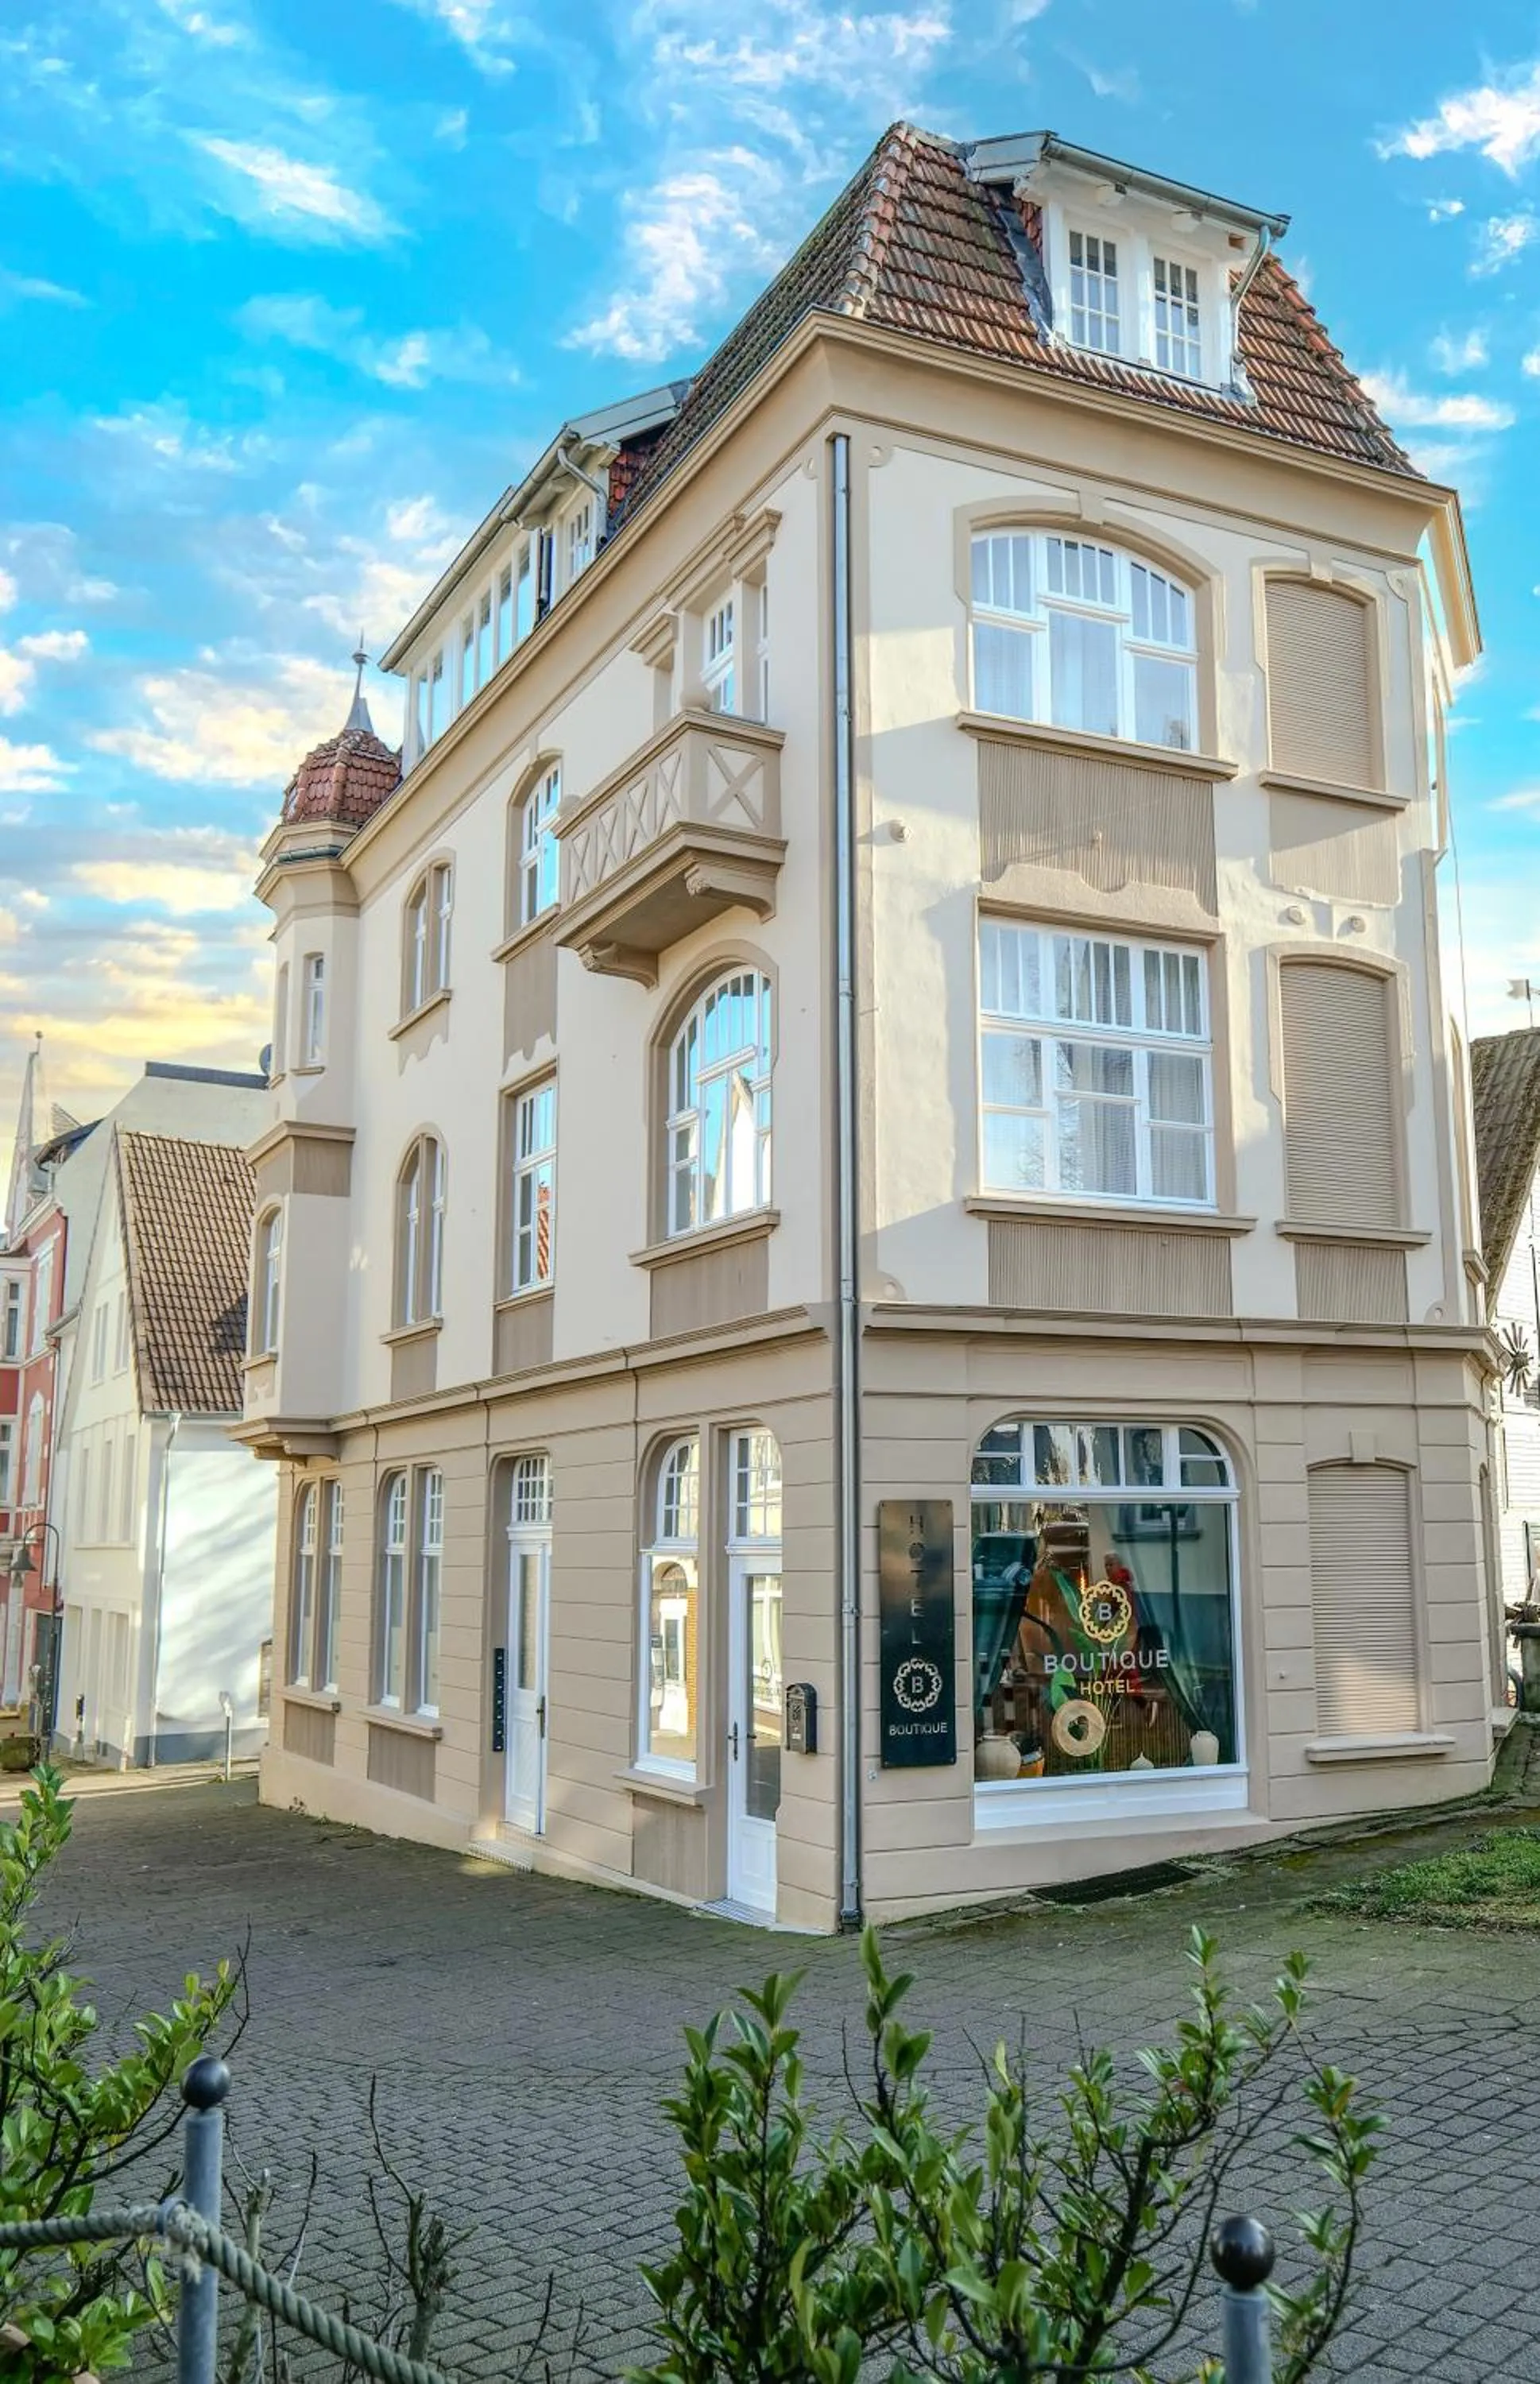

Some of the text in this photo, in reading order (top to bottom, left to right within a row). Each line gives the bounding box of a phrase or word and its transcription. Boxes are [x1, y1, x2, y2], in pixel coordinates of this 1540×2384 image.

[1098, 1602, 1112, 1620] B
[1043, 1649, 1169, 1674] BOUTIQUE
[911, 1676, 923, 1693] B
[1080, 1679, 1135, 1695] HOTEL
[889, 1721, 948, 1736] BOUTIQUE
